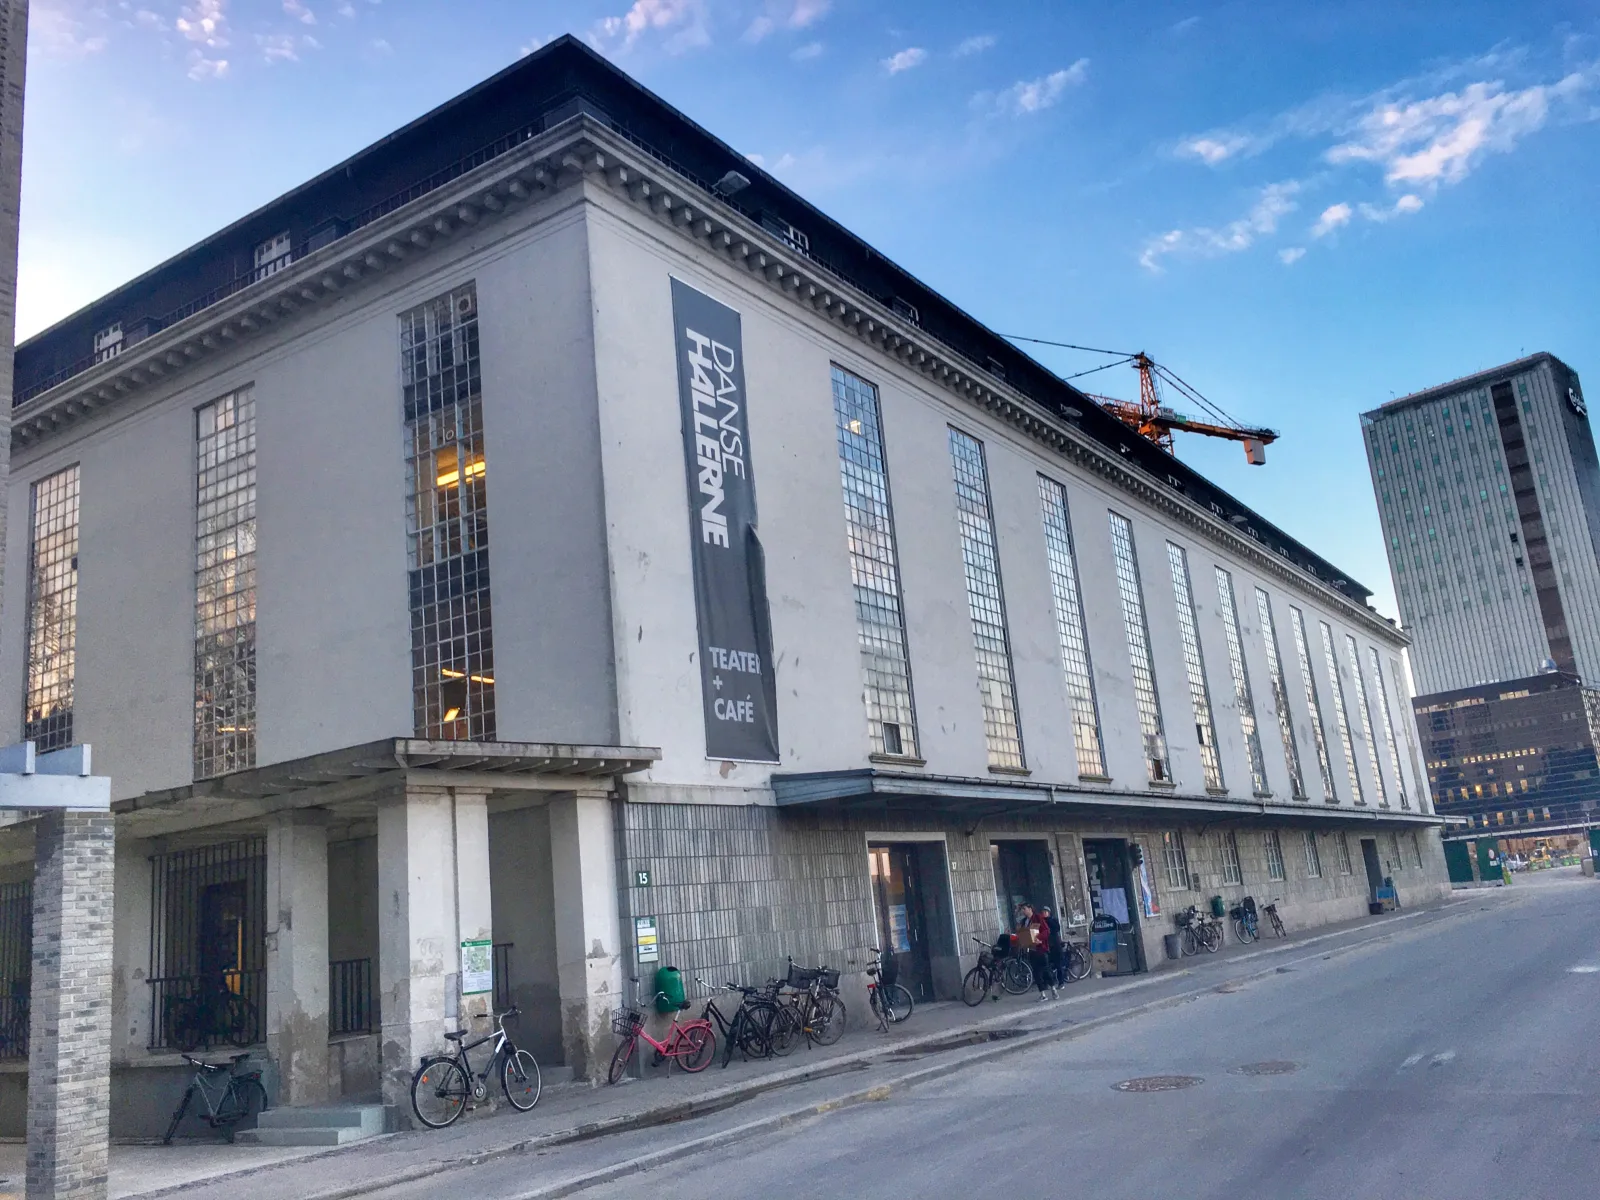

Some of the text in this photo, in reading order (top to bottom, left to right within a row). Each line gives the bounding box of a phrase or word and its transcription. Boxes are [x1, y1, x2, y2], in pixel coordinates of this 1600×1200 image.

[686, 327, 730, 549] HALLERNE
[711, 339, 745, 480] DANSE
[714, 693, 755, 723] CAFÉ
[639, 872, 648, 884] 15
